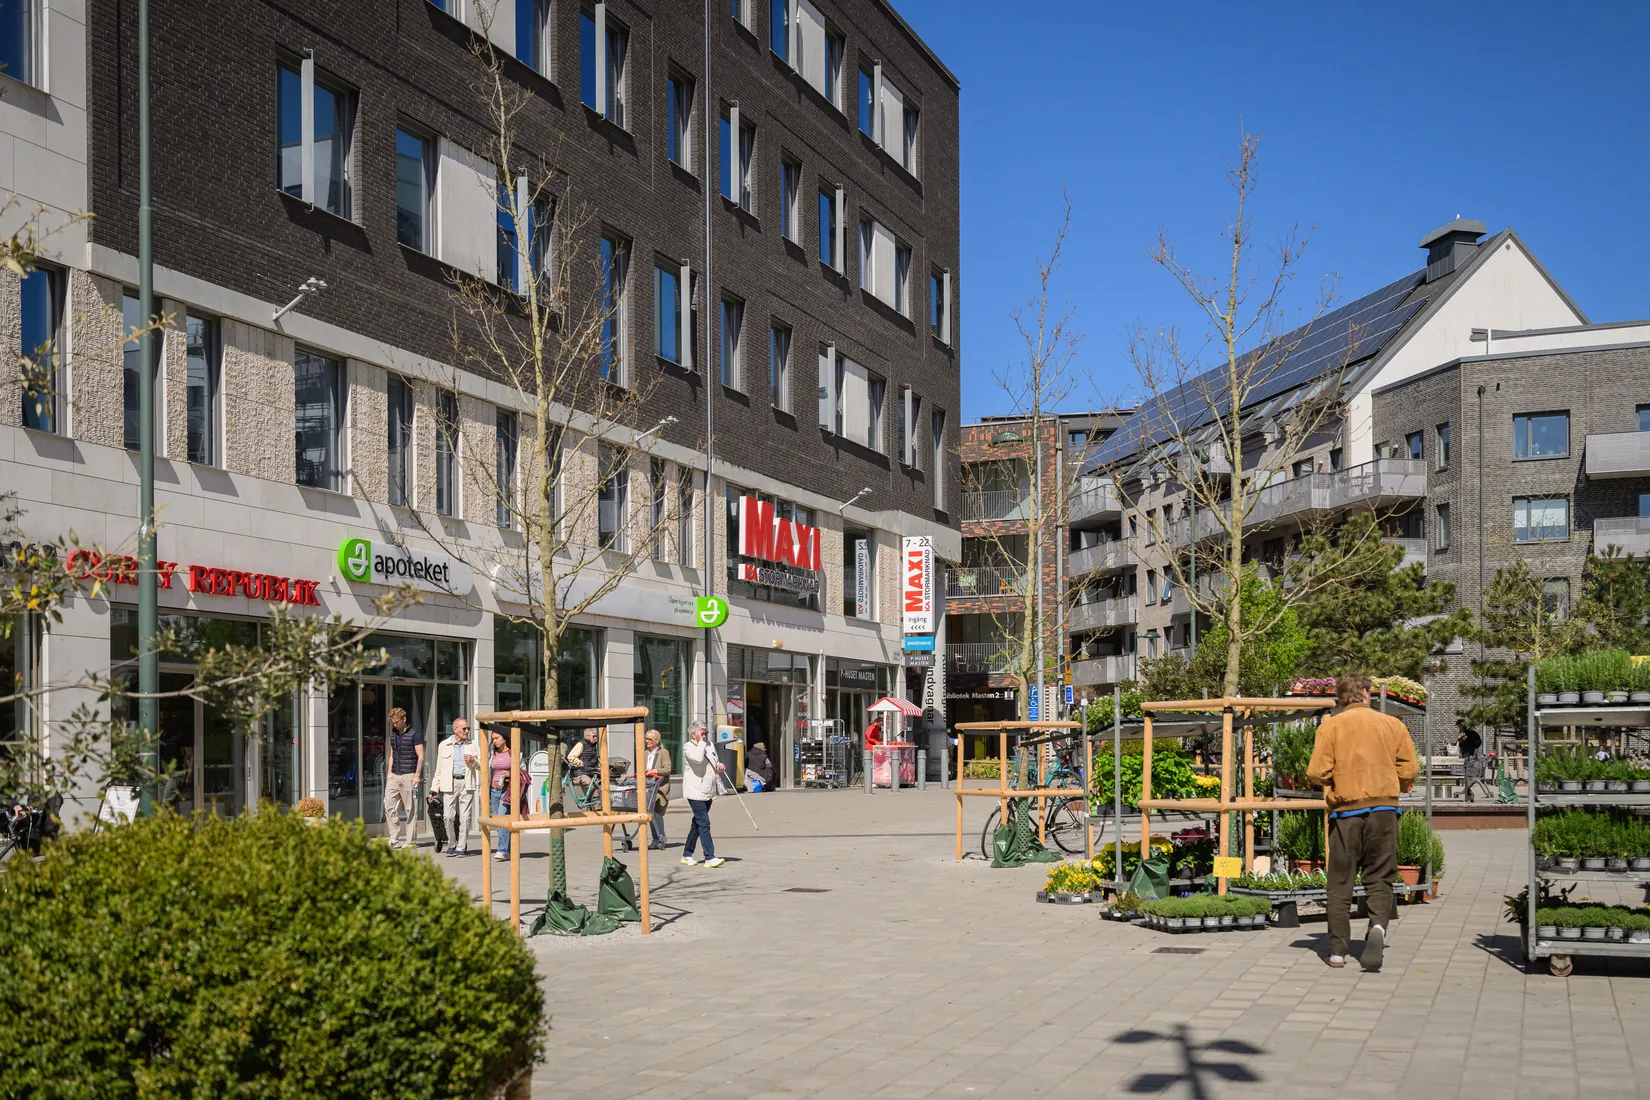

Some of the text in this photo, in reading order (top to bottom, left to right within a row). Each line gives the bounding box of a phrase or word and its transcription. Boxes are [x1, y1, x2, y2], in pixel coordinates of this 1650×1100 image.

[740, 496, 821, 572] MAXI
[919, 538, 930, 547] 22
[66, 549, 179, 590] CURY
[188, 564, 321, 607] REPUBLIK
[374, 553, 450, 583] apoteket
[741, 563, 820, 595] ICA STORMARKNAD
[904, 550, 924, 613] MAXI
[907, 616, 928, 624] Ingång
[925, 666, 936, 725] ndvagnar
